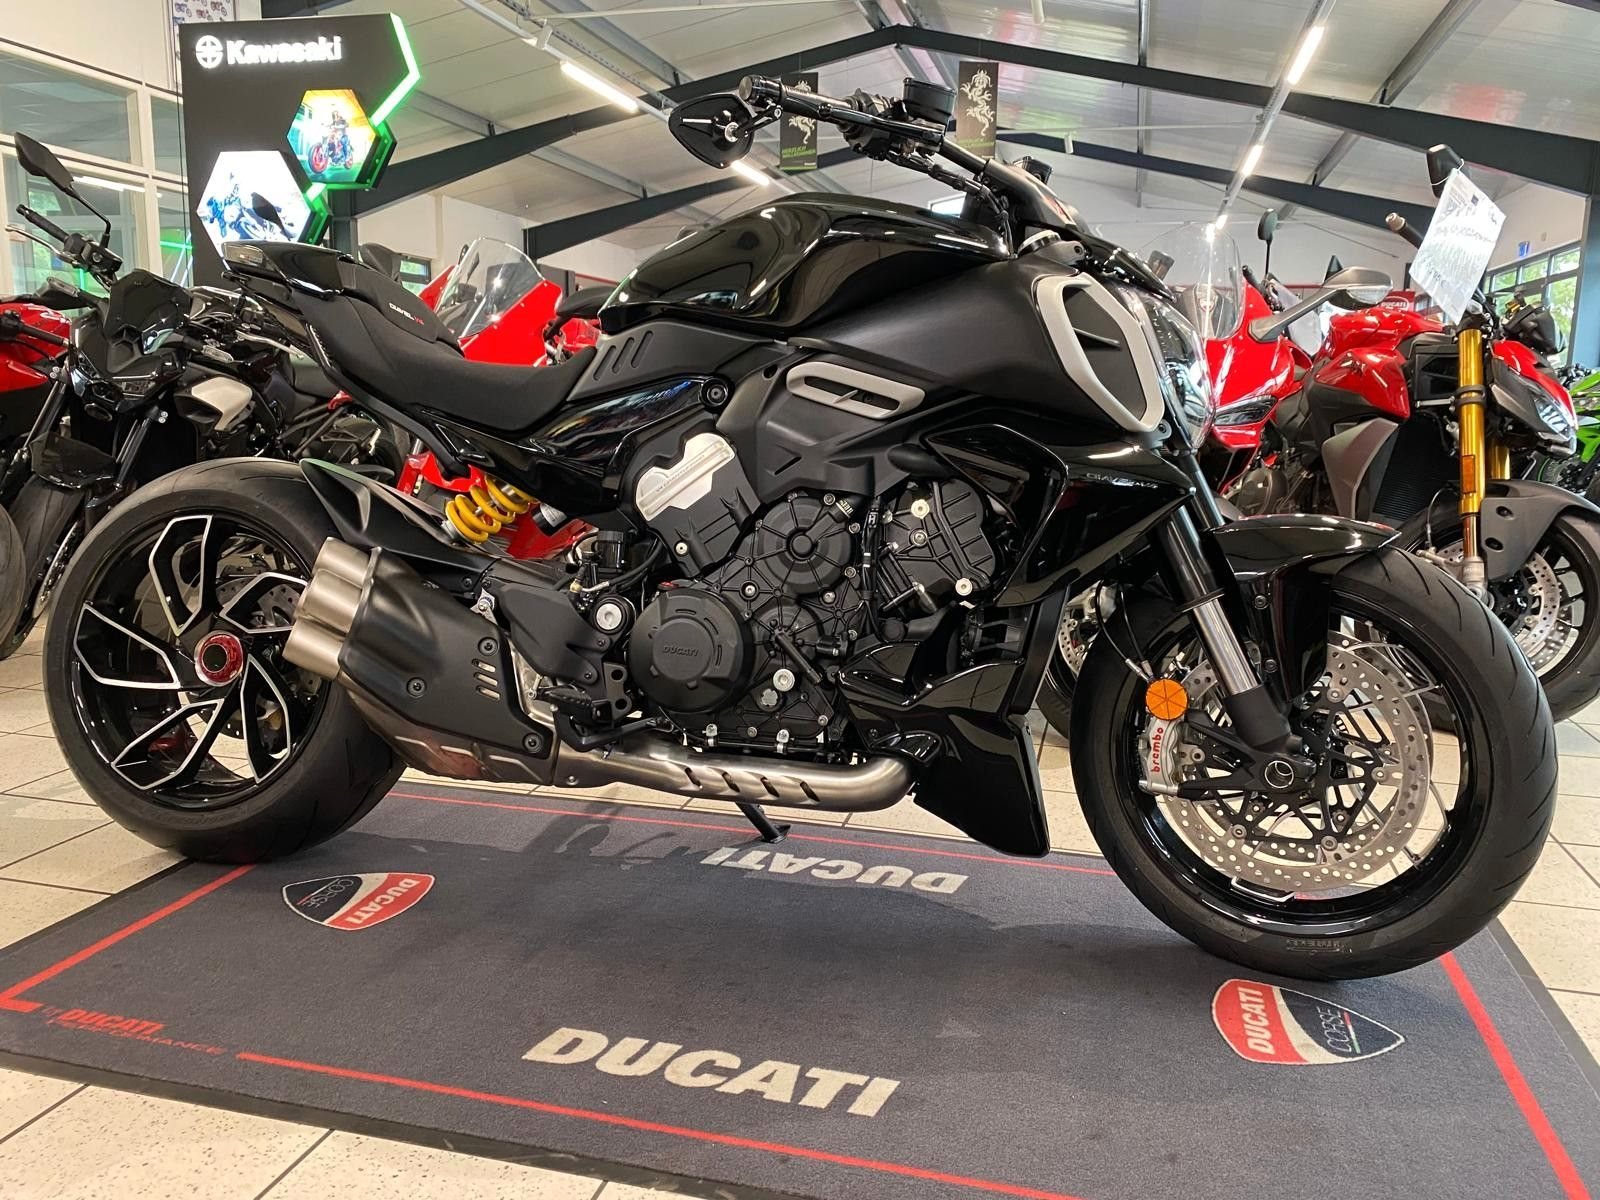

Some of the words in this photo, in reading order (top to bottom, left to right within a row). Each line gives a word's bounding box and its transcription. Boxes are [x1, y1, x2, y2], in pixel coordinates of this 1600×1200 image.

[226, 36, 342, 65] Kawasaki
[662, 646, 700, 657] DUCATI
[1150, 727, 1164, 772] brembo
[700, 846, 969, 894] DUCATI
[303, 878, 353, 909] CORSE
[345, 878, 421, 925] DUCATI
[57, 1008, 167, 1035] DUCATI
[1236, 986, 1276, 1056] DUCATI
[1316, 1005, 1352, 1053] CORSE
[521, 1027, 900, 1118] DUCATI
